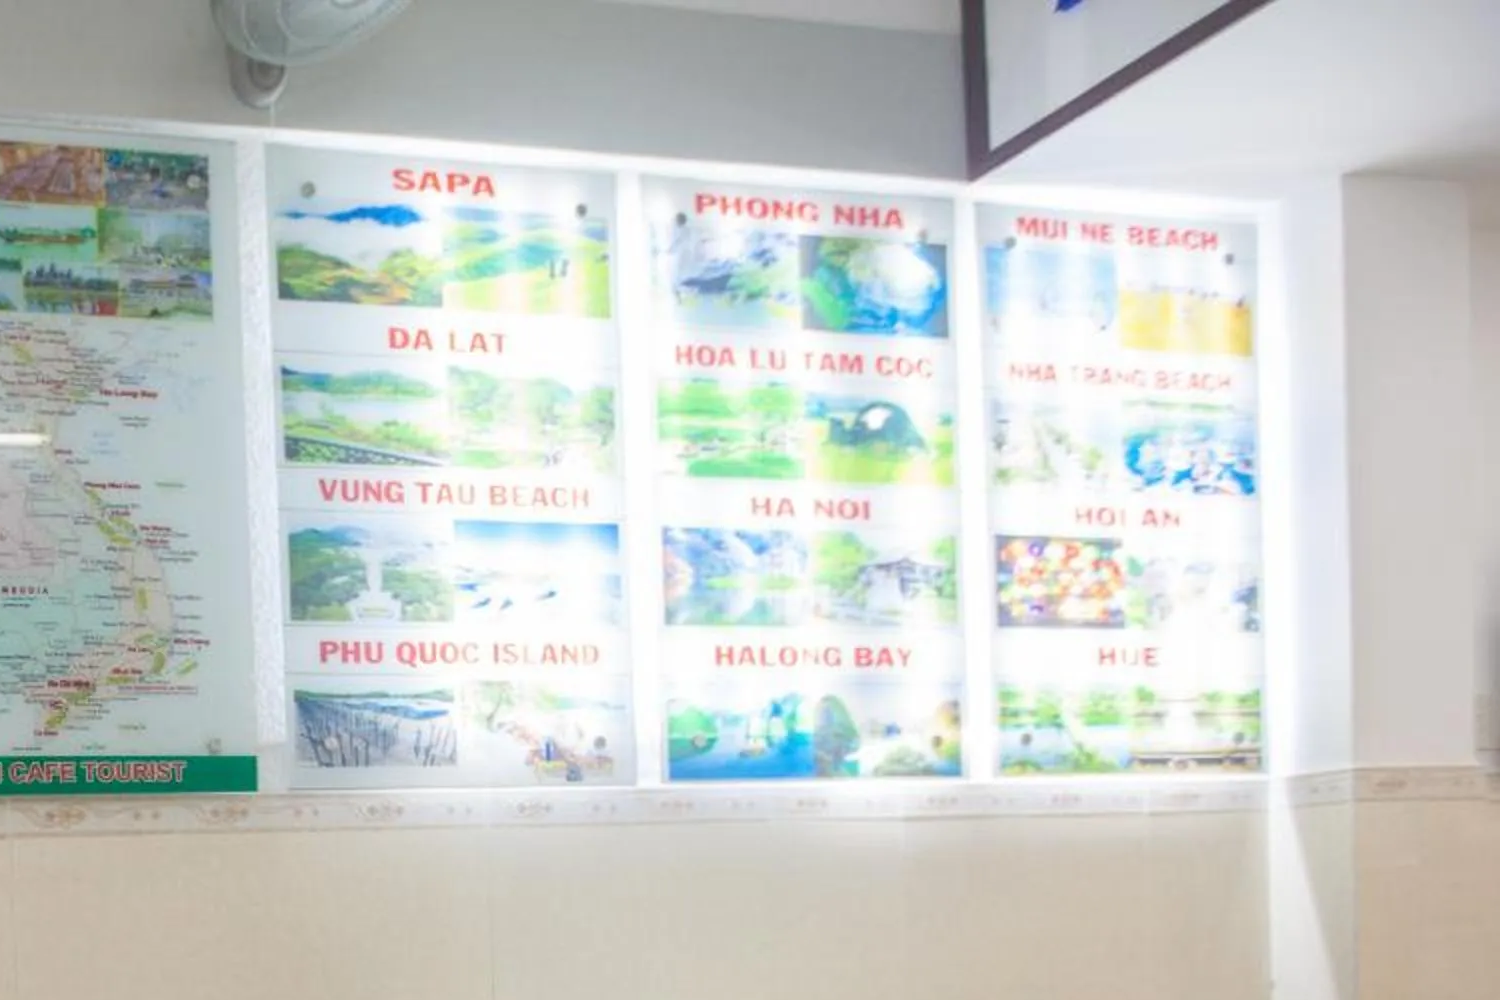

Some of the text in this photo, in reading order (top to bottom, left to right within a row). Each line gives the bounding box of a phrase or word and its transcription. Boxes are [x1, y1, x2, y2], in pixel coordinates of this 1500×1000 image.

[392, 169, 496, 197] SAPA
[694, 193, 904, 229] PHONG NHA
[1016, 216, 1219, 250] MUI NE BEACH
[388, 327, 506, 354] DA LAT
[675, 345, 934, 378] HOA LU TAM COC
[1008, 363, 1057, 382] NHA
[1154, 370, 1232, 391] BEACH
[318, 478, 590, 509] VUNG TAU BEACH
[751, 497, 871, 521] HA NOI
[1075, 507, 1181, 528] HOI AN
[319, 641, 600, 667] PHU QUOC ISLAND
[715, 645, 913, 668] HALONG BAY
[1098, 647, 1160, 667] HUE
[9, 761, 76, 784] CAFE
[85, 761, 187, 783] TOURIST
